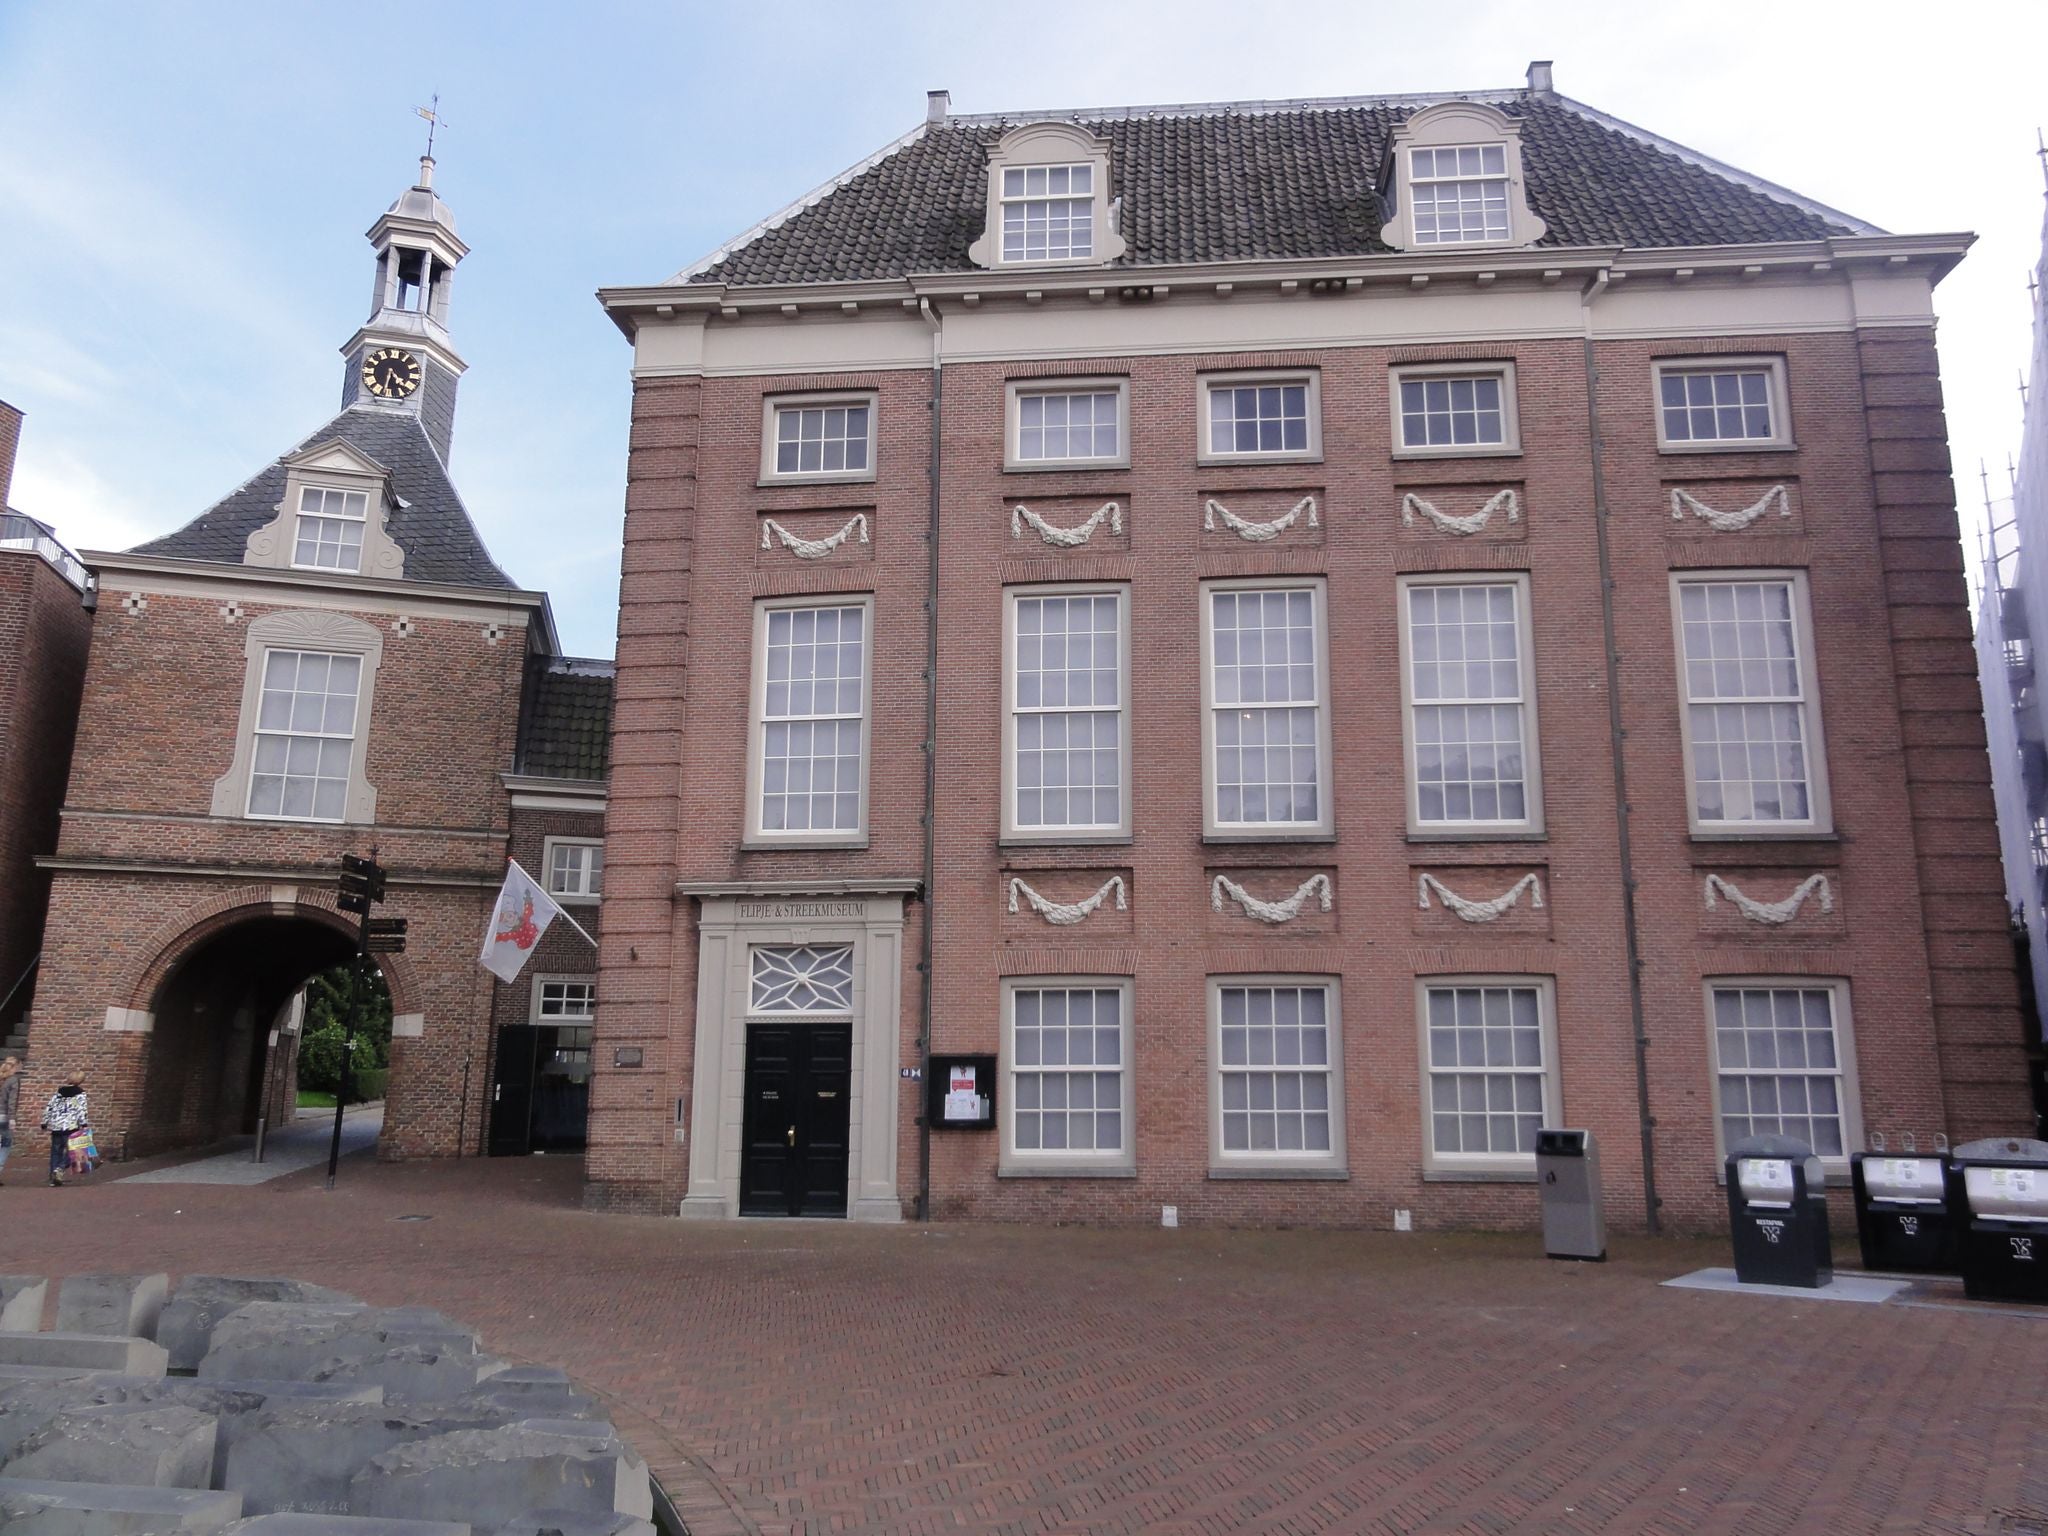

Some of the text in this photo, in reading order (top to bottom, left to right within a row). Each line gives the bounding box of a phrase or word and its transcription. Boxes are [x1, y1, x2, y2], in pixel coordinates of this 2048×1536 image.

[740, 903, 864, 918] FLIPJE & STREEKMUSEUM
